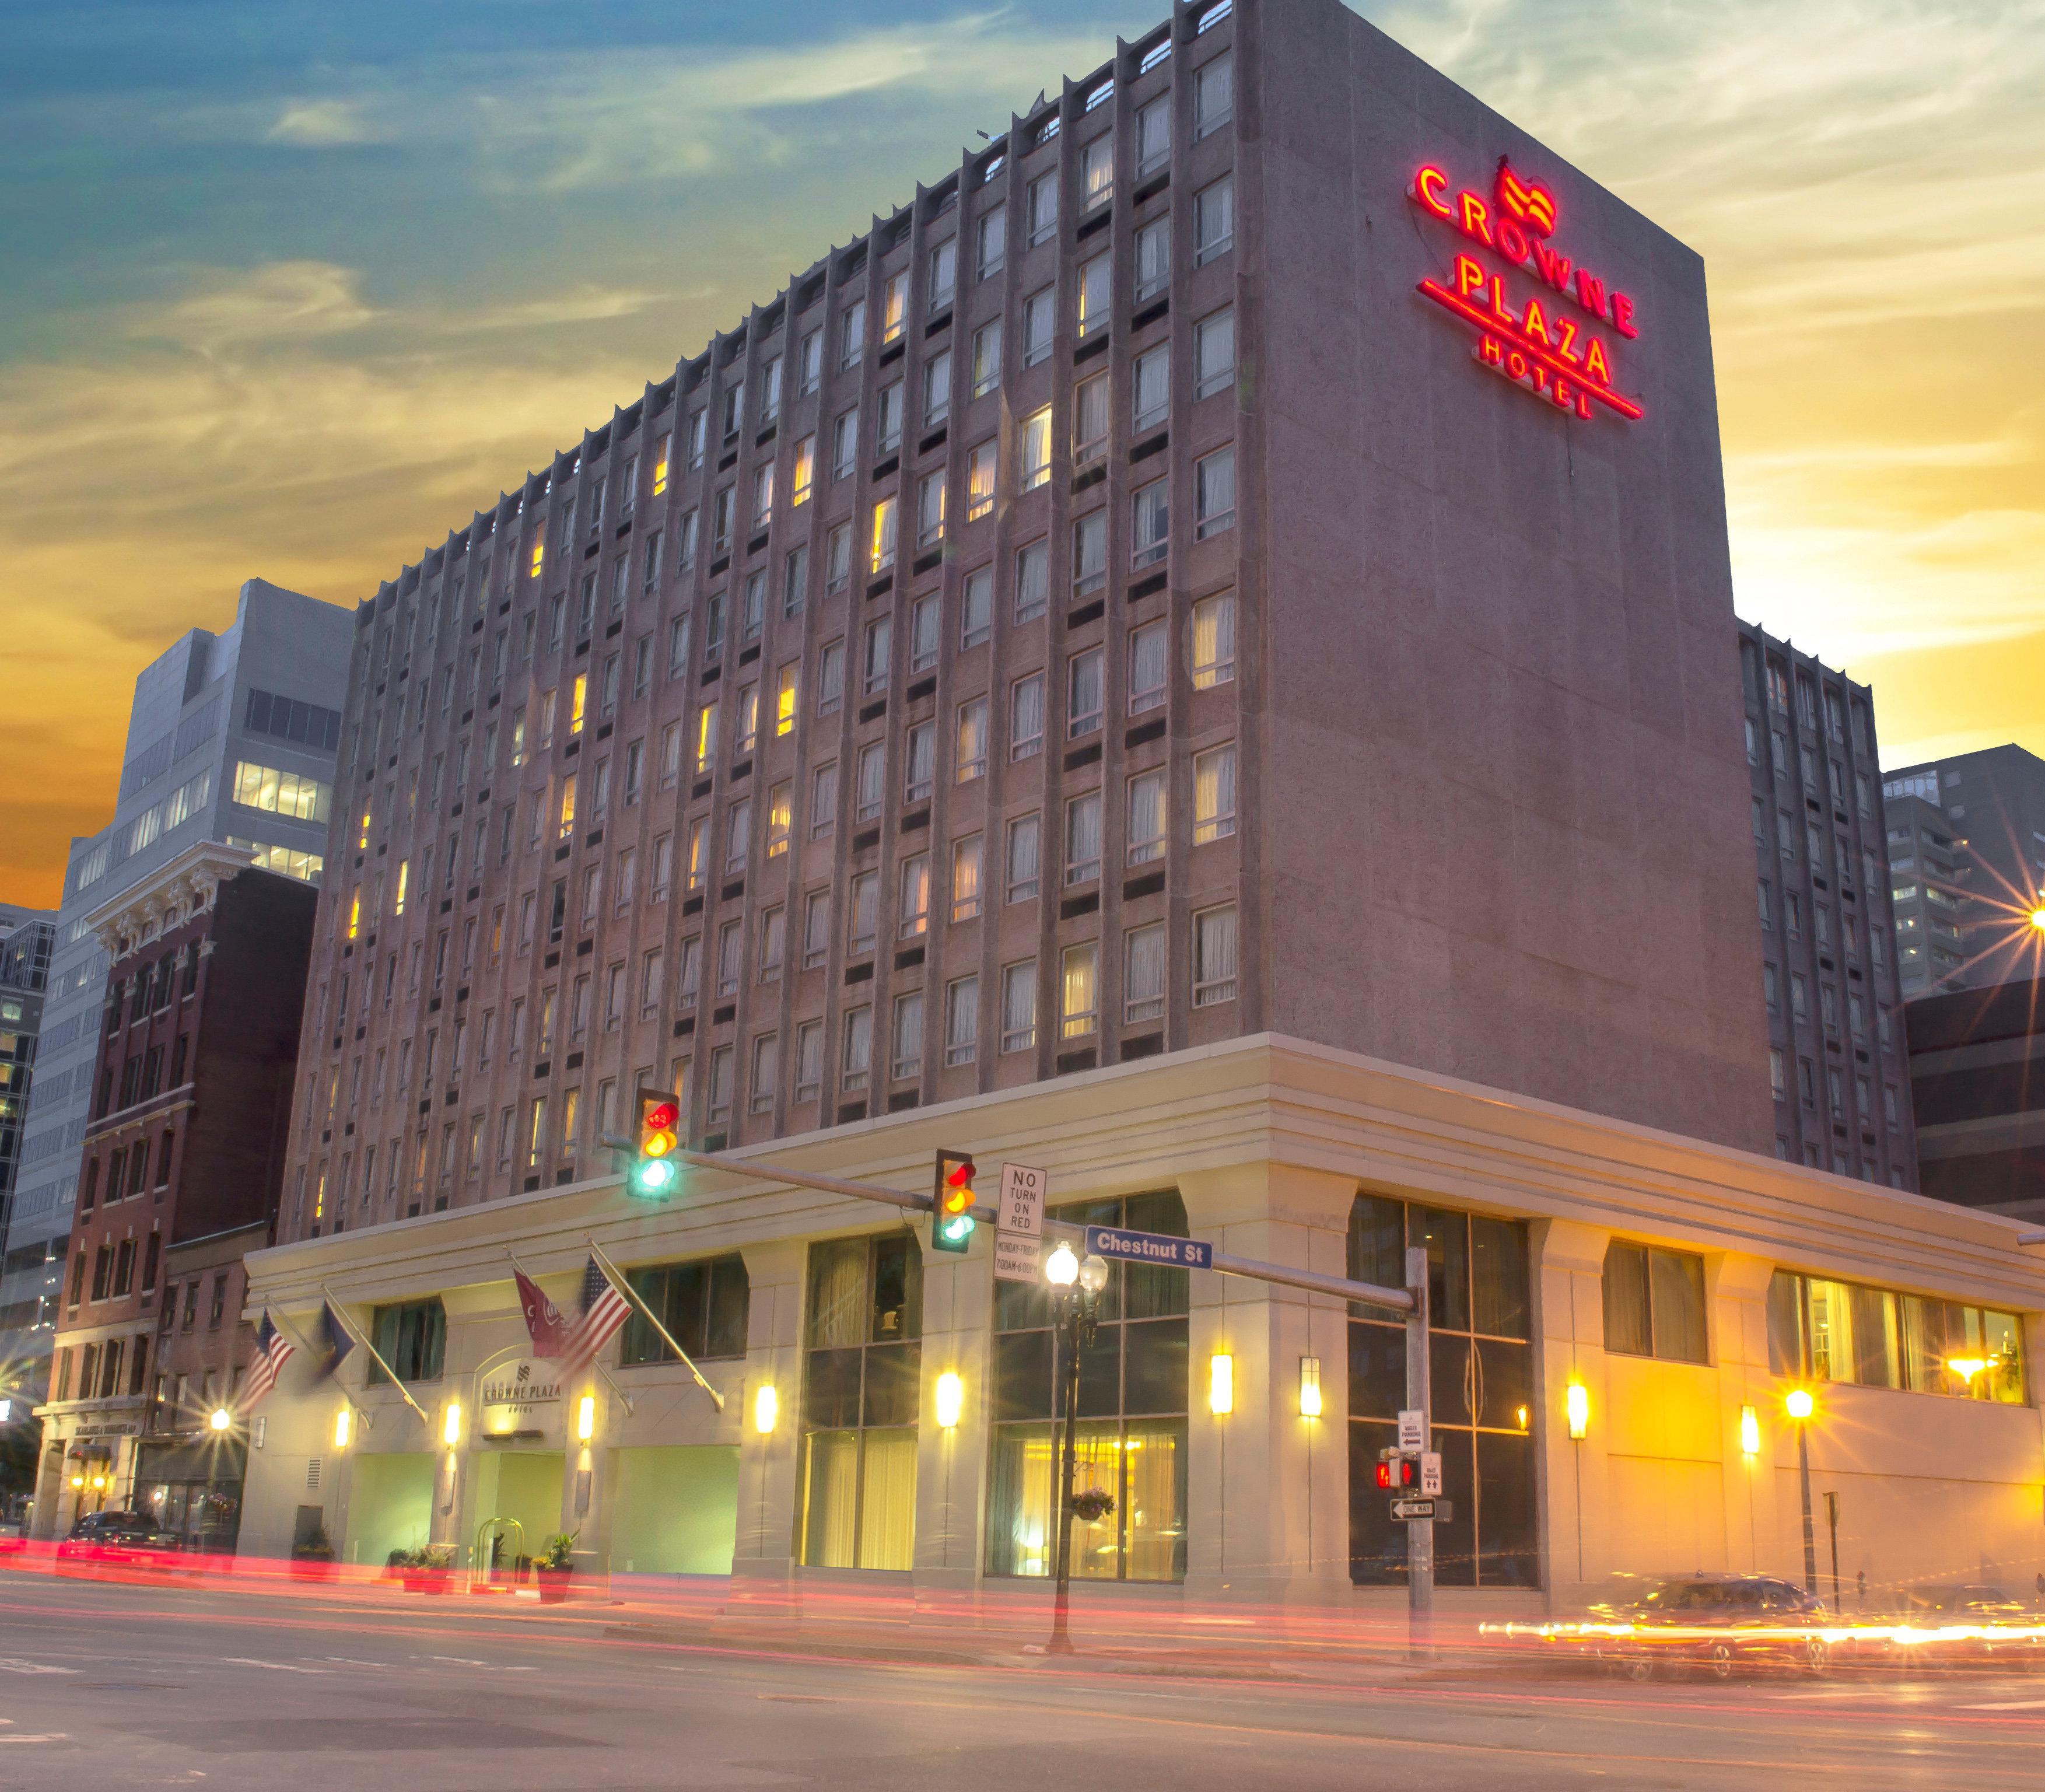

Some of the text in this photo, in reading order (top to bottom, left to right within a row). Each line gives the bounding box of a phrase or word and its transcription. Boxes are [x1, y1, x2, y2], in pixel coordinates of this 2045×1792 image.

[1415, 166, 1638, 340] CROWNE
[1454, 252, 1611, 387] PLAZA
[1479, 334, 1592, 420] HOTEL
[1013, 1170, 1036, 1187] NO
[1010, 1186, 1036, 1202] TURN
[1014, 1202, 1029, 1214] ON
[1011, 1216, 1031, 1229] RED
[1097, 1232, 1203, 1263] Chestnut St
[485, 1384, 561, 1402] CROWNE PLAZA
[1403, 1504, 1430, 1513] ONE WAY
